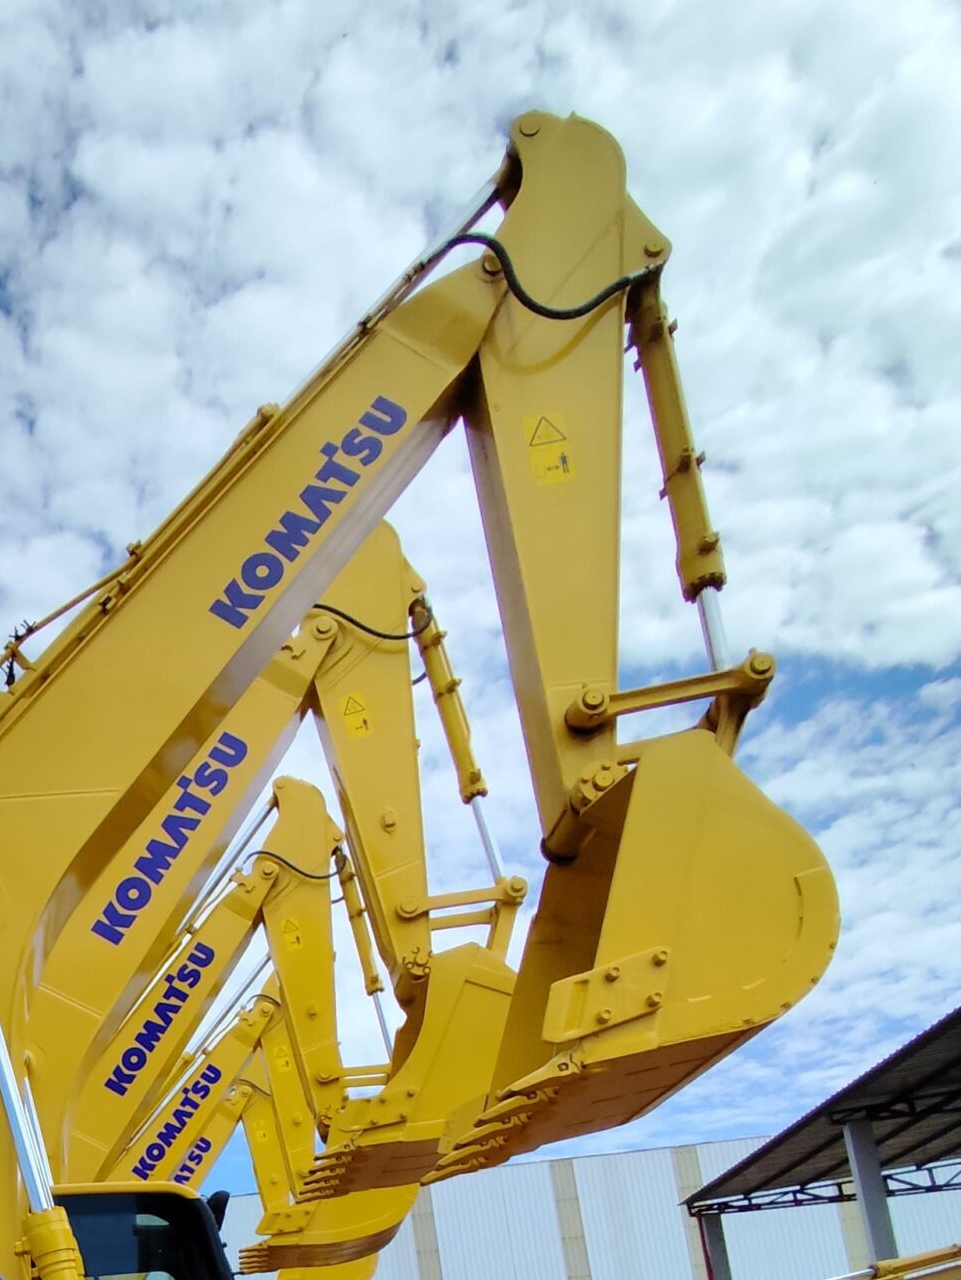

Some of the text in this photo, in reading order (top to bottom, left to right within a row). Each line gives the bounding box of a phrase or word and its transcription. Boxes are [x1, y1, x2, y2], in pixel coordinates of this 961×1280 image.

[209, 395, 408, 629] KOMATSU
[91, 731, 248, 946] KOMATSU
[104, 942, 215, 1096] KOMATSU
[132, 1064, 222, 1180] KOMATSU
